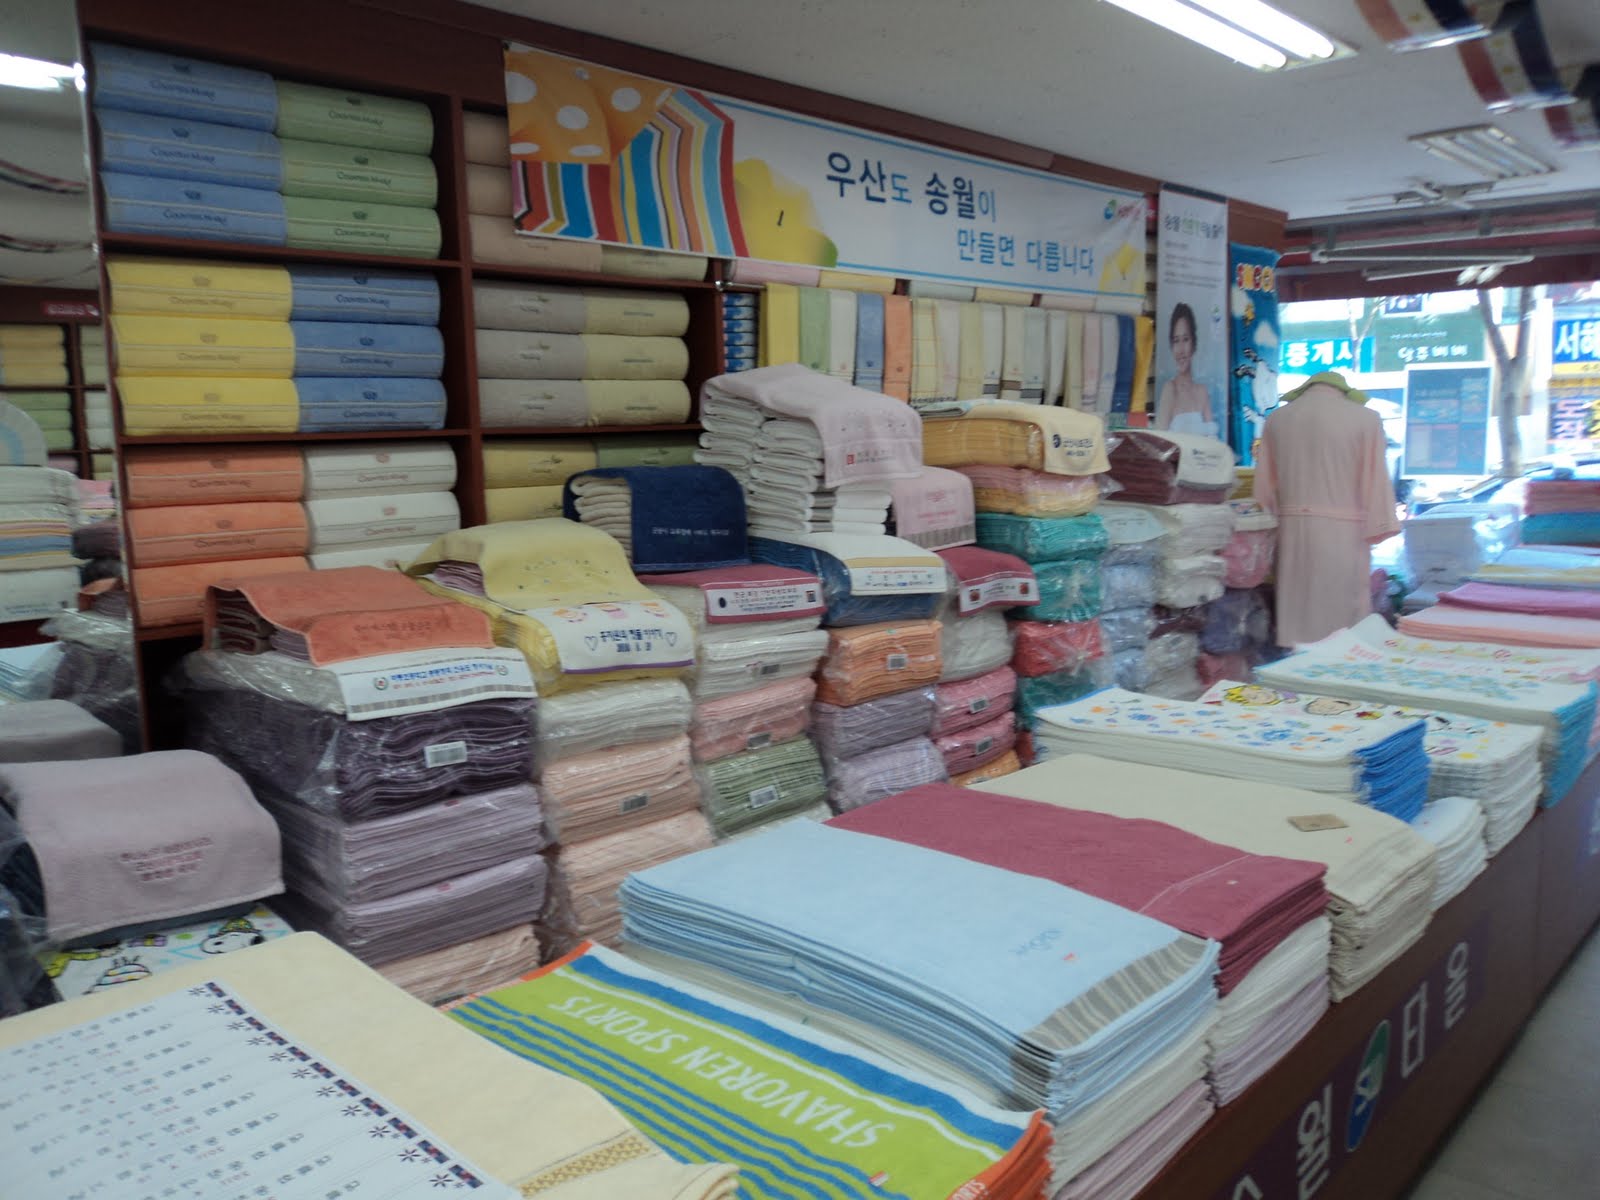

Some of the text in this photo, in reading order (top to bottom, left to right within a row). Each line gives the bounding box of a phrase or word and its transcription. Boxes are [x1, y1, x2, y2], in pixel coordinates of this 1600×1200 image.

[826, 152, 997, 223] 우산도 송월이
[957, 228, 1095, 278] 만들면 다릅니다
[548, 995, 895, 1148] SHAVOREN SPORTS
